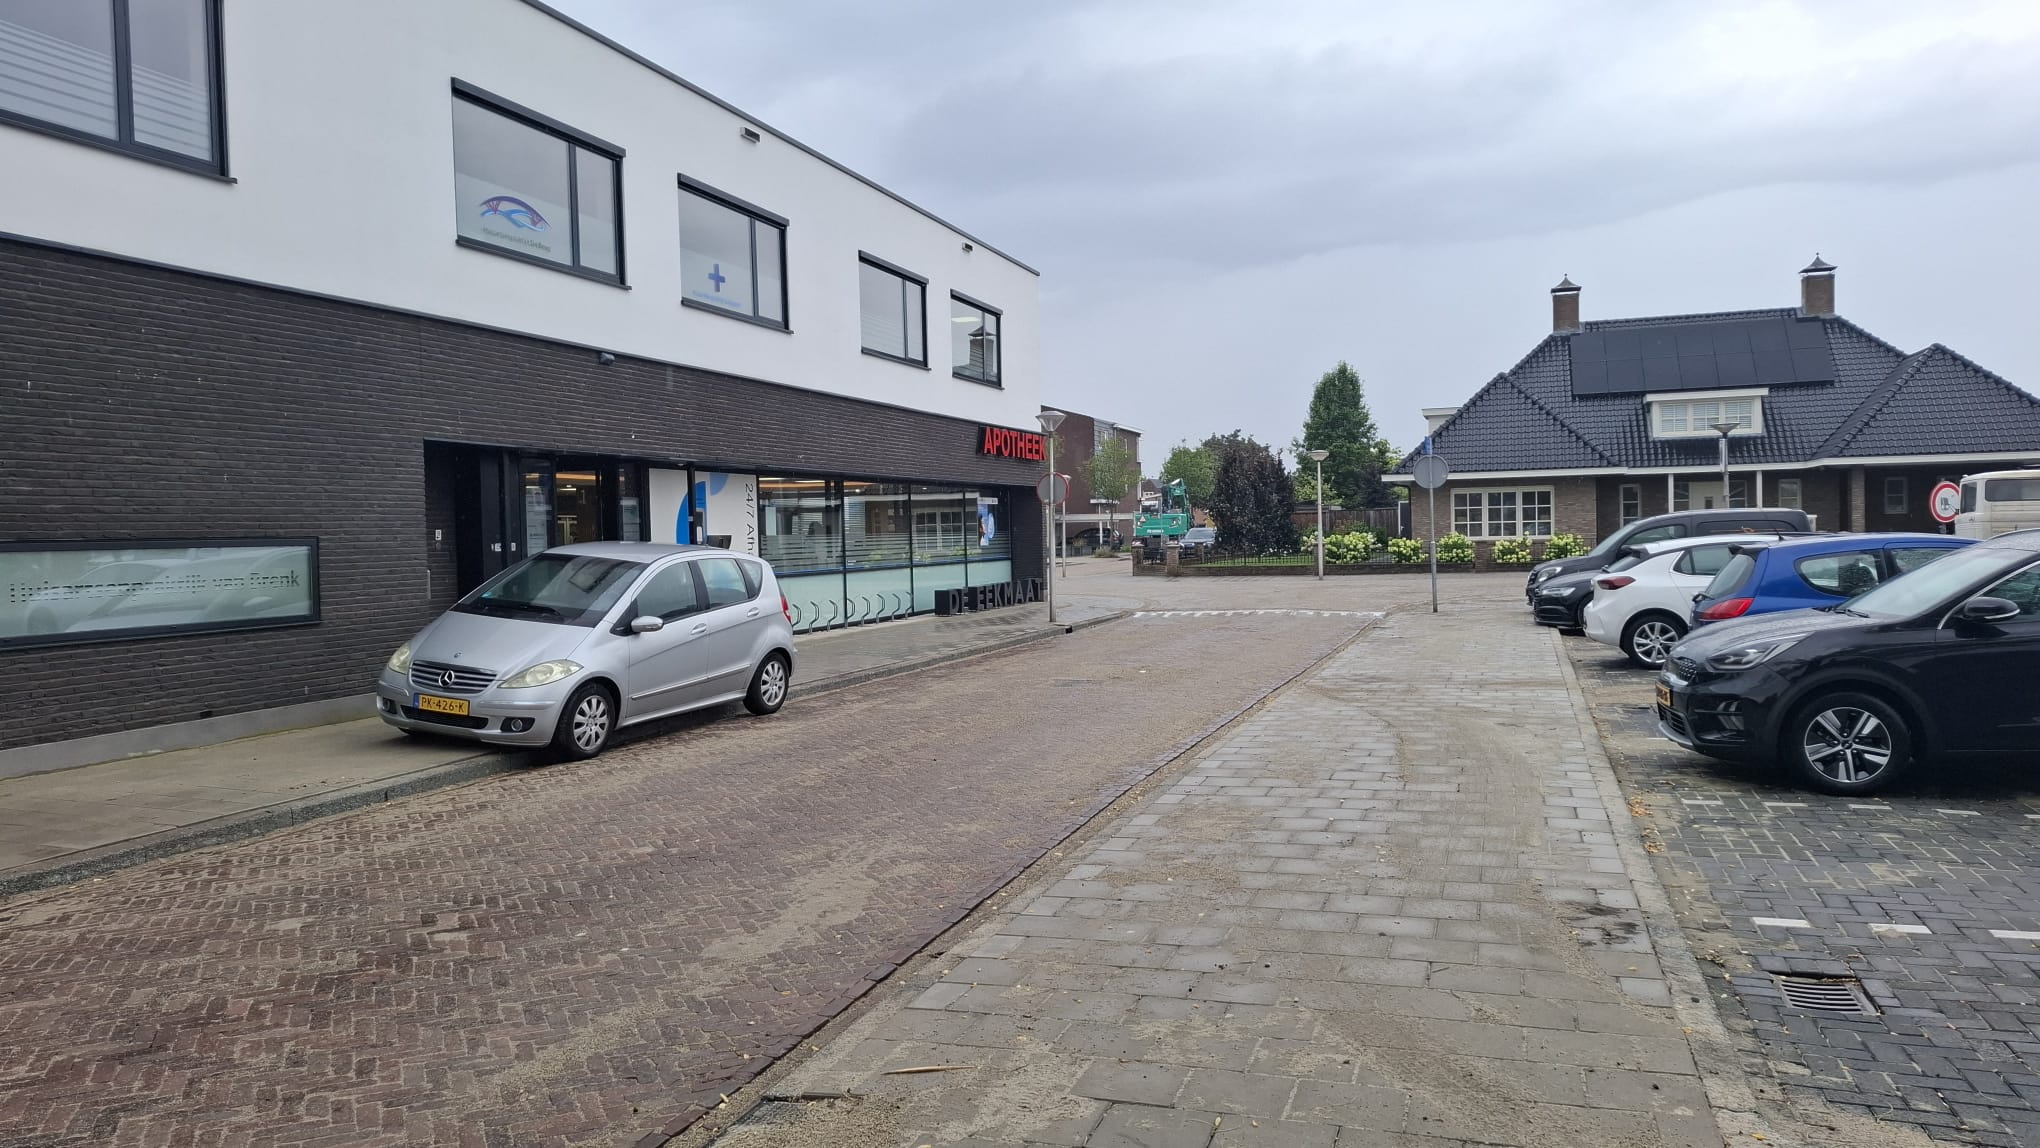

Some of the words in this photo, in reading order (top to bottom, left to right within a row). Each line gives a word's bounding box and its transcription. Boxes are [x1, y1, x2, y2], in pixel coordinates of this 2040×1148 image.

[983, 426, 1048, 461] APOTHEEK
[745, 483, 755, 518] 24/7
[746, 523, 755, 555] Afh
[948, 587, 969, 614] DE
[977, 578, 1044, 612] EEKMAAT
[421, 696, 465, 713] PK-426-K
